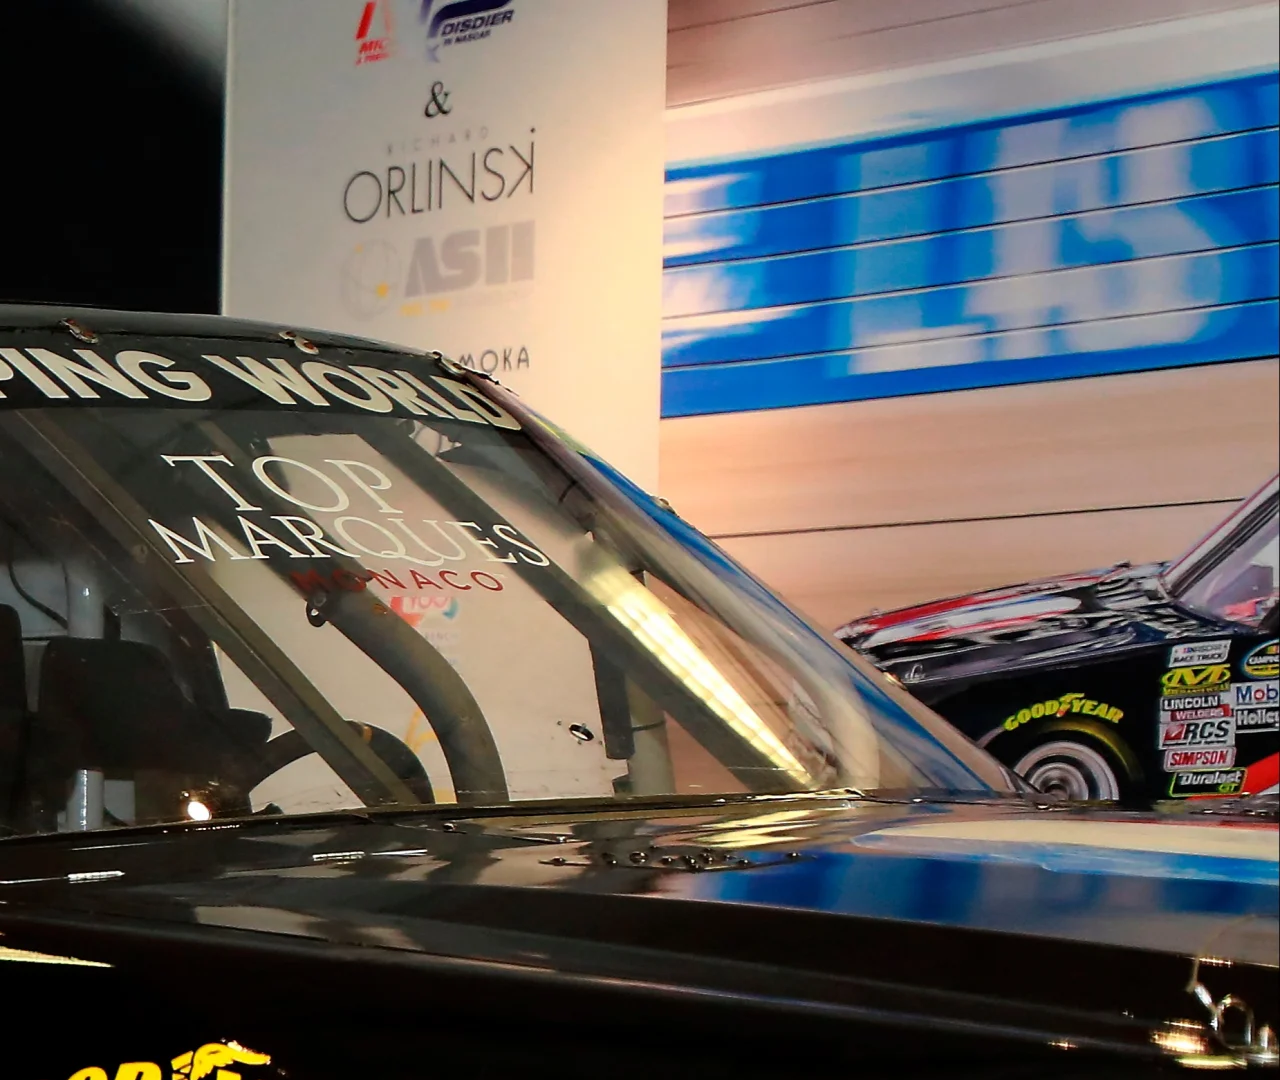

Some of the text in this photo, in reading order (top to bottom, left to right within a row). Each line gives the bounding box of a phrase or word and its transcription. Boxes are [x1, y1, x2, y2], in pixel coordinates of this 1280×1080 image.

[441, 9, 514, 37] DISDIER
[424, 81, 452, 118] &
[218, 354, 522, 431] WORLD
[160, 453, 403, 515] TOP
[148, 515, 551, 568] MARQUES
[289, 567, 505, 593] MONACO
[1164, 695, 1218, 710] LINCOLN
[1236, 684, 1278, 703] Mob
[1004, 692, 1124, 731] GOODYEAR
[1184, 720, 1230, 740] RCS
[1170, 751, 1228, 766] SIMPSON
[1179, 771, 1243, 786] Duralast
